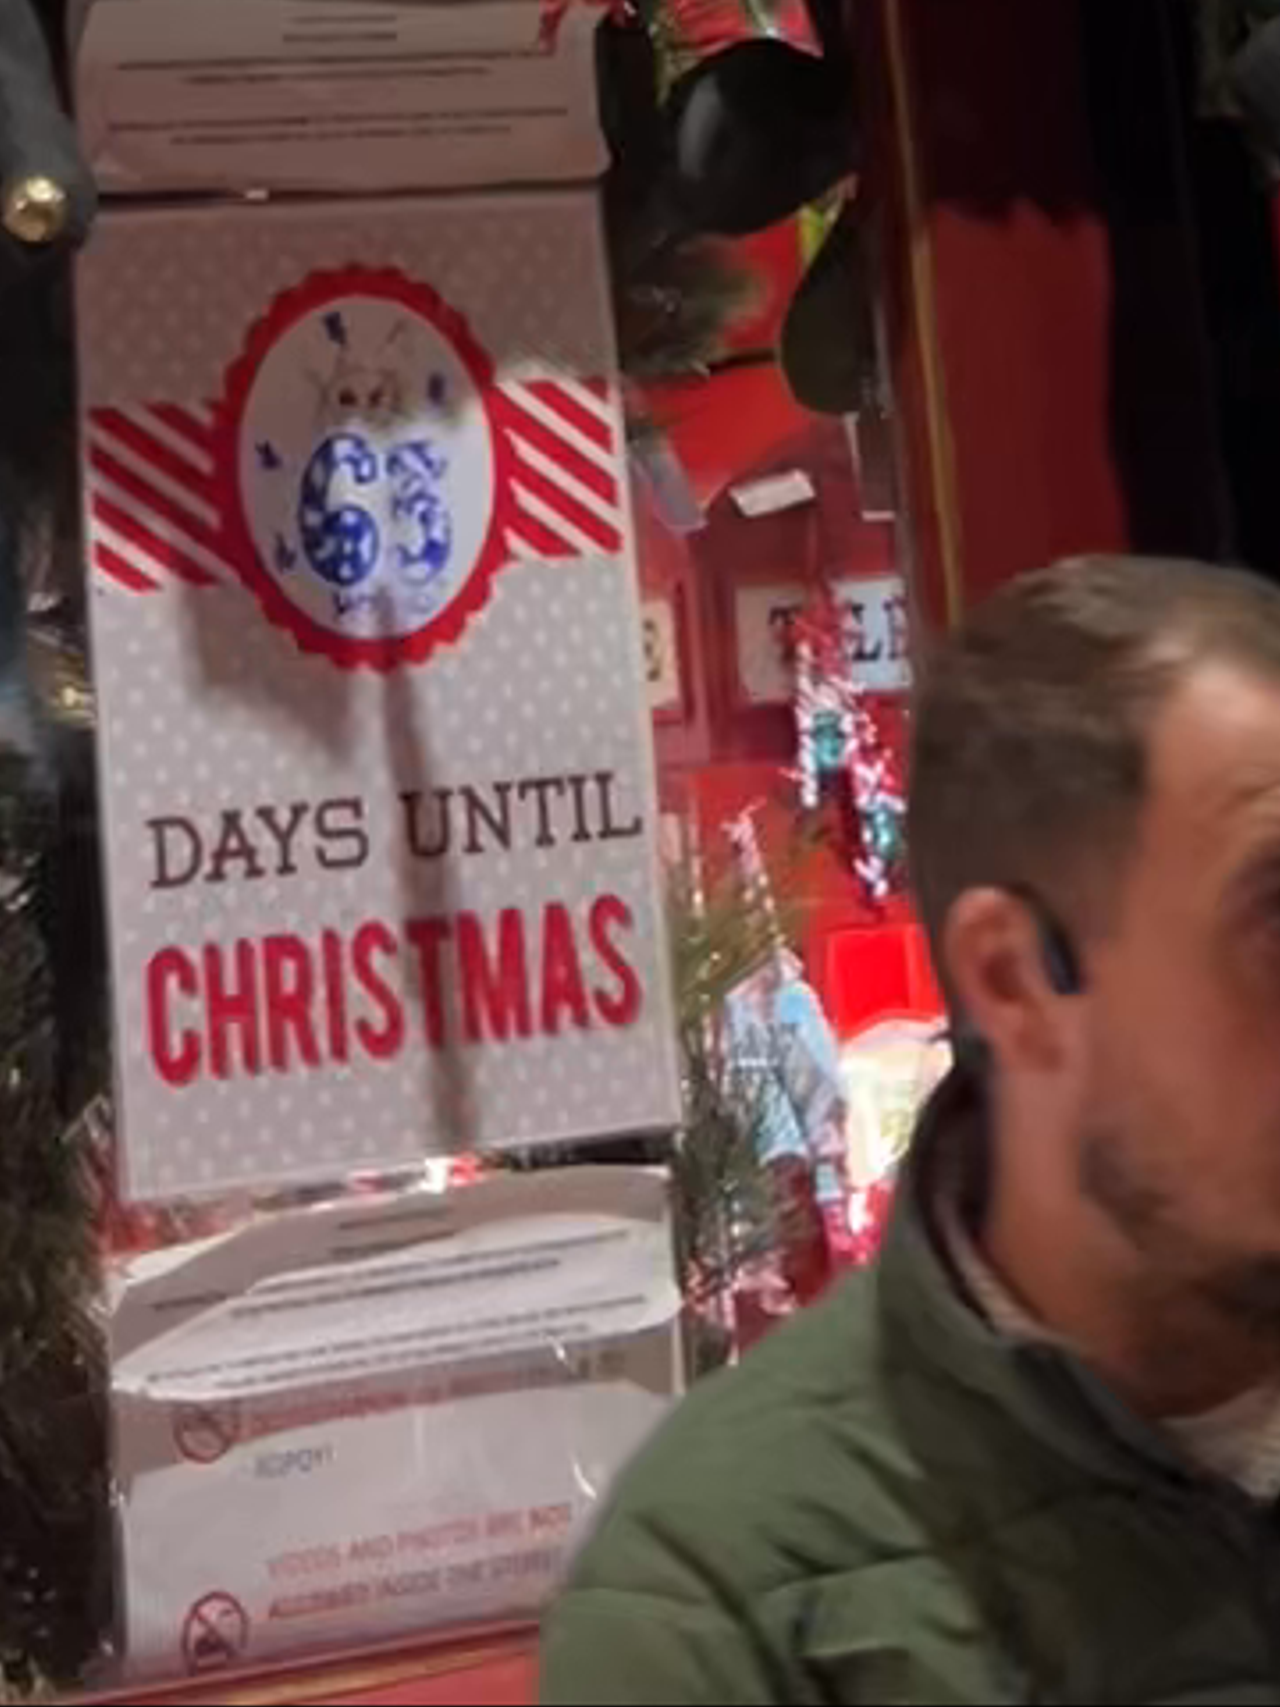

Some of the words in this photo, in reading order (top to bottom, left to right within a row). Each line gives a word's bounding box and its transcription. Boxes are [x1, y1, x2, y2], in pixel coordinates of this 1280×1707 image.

[146, 797, 369, 890] DAYS
[398, 771, 644, 860] UNTIL
[145, 892, 644, 1090] CHRISTMAS
